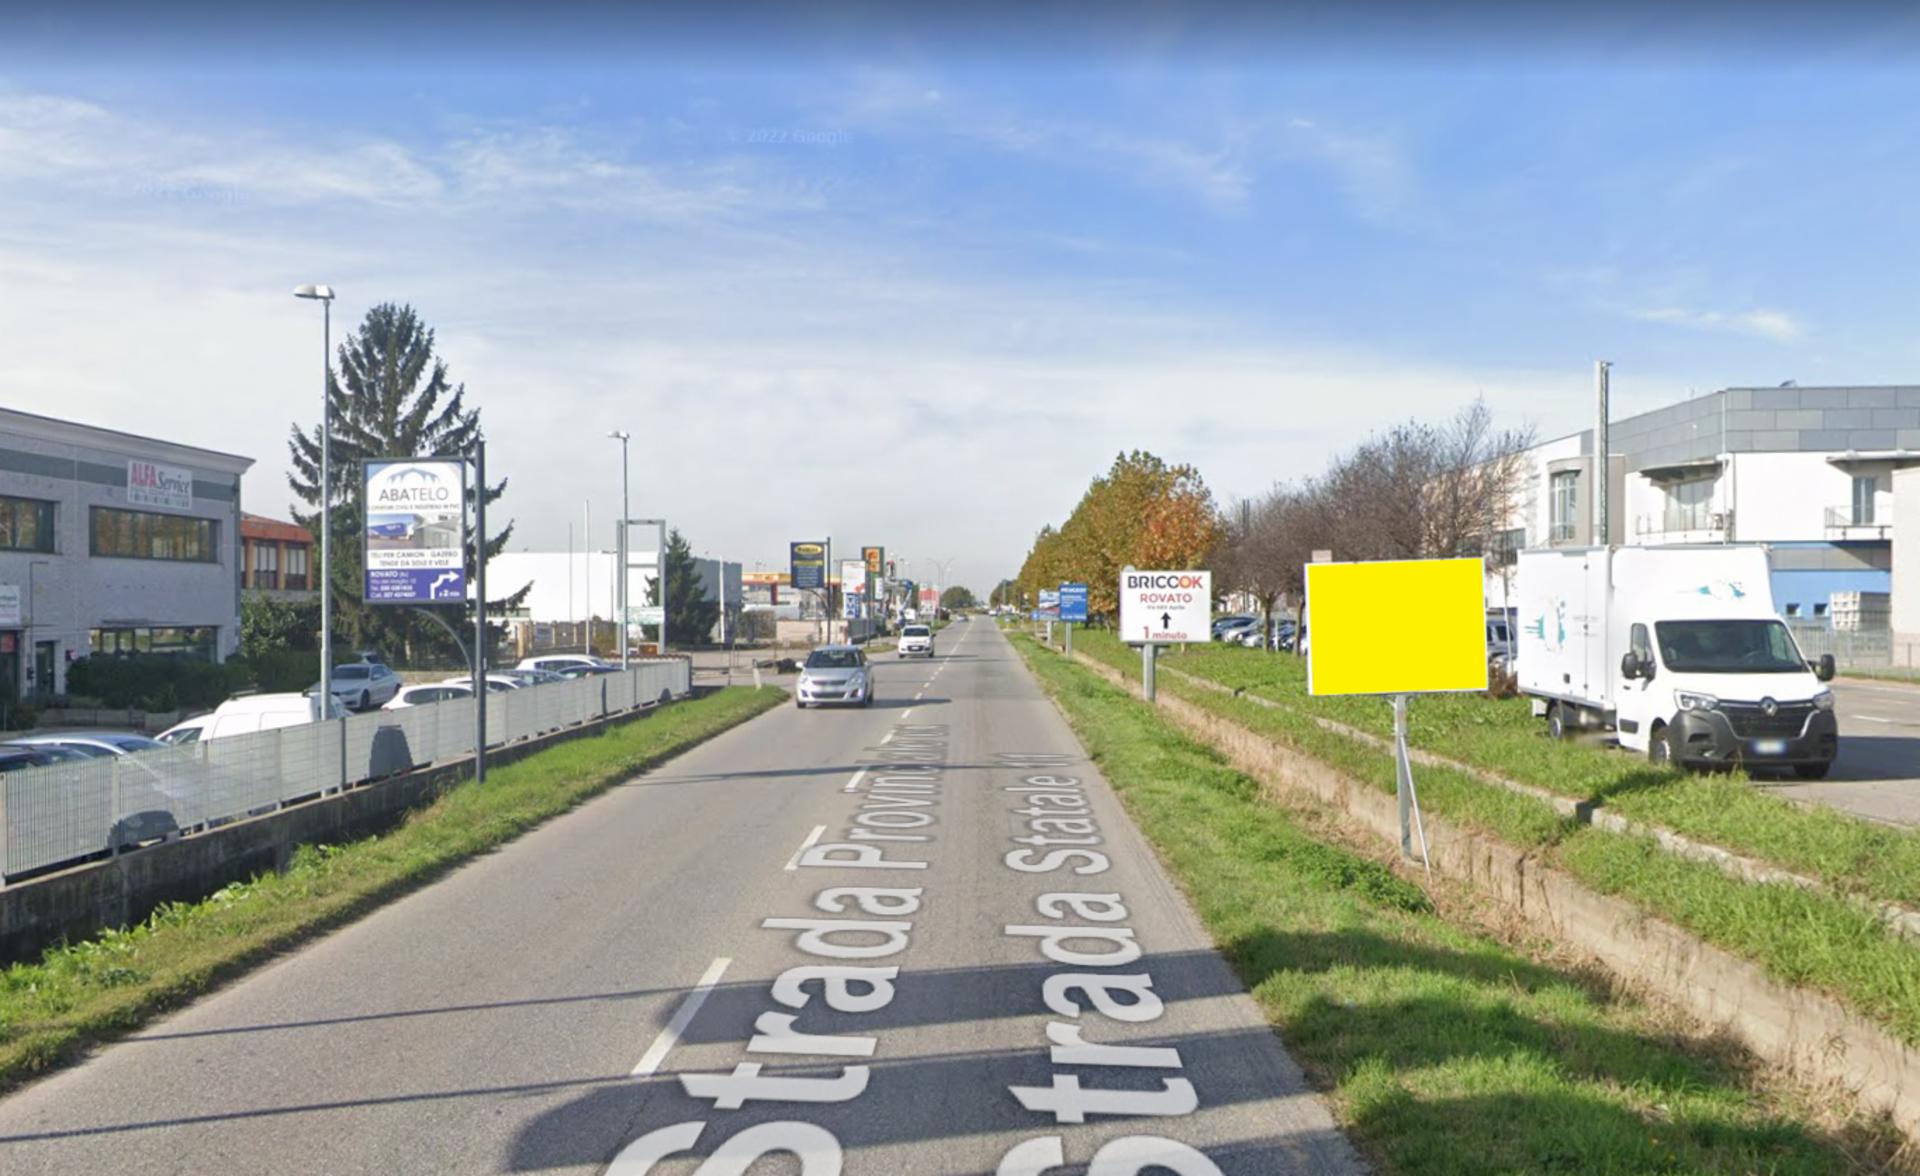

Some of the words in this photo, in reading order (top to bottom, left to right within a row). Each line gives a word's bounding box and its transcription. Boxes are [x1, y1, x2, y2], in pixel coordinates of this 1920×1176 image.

[131, 462, 157, 488] ALFA
[378, 487, 449, 502] ABATELO
[1140, 593, 1193, 603] ROVATO
[1142, 626, 1149, 639] 1
[1152, 631, 1188, 639] minuto
